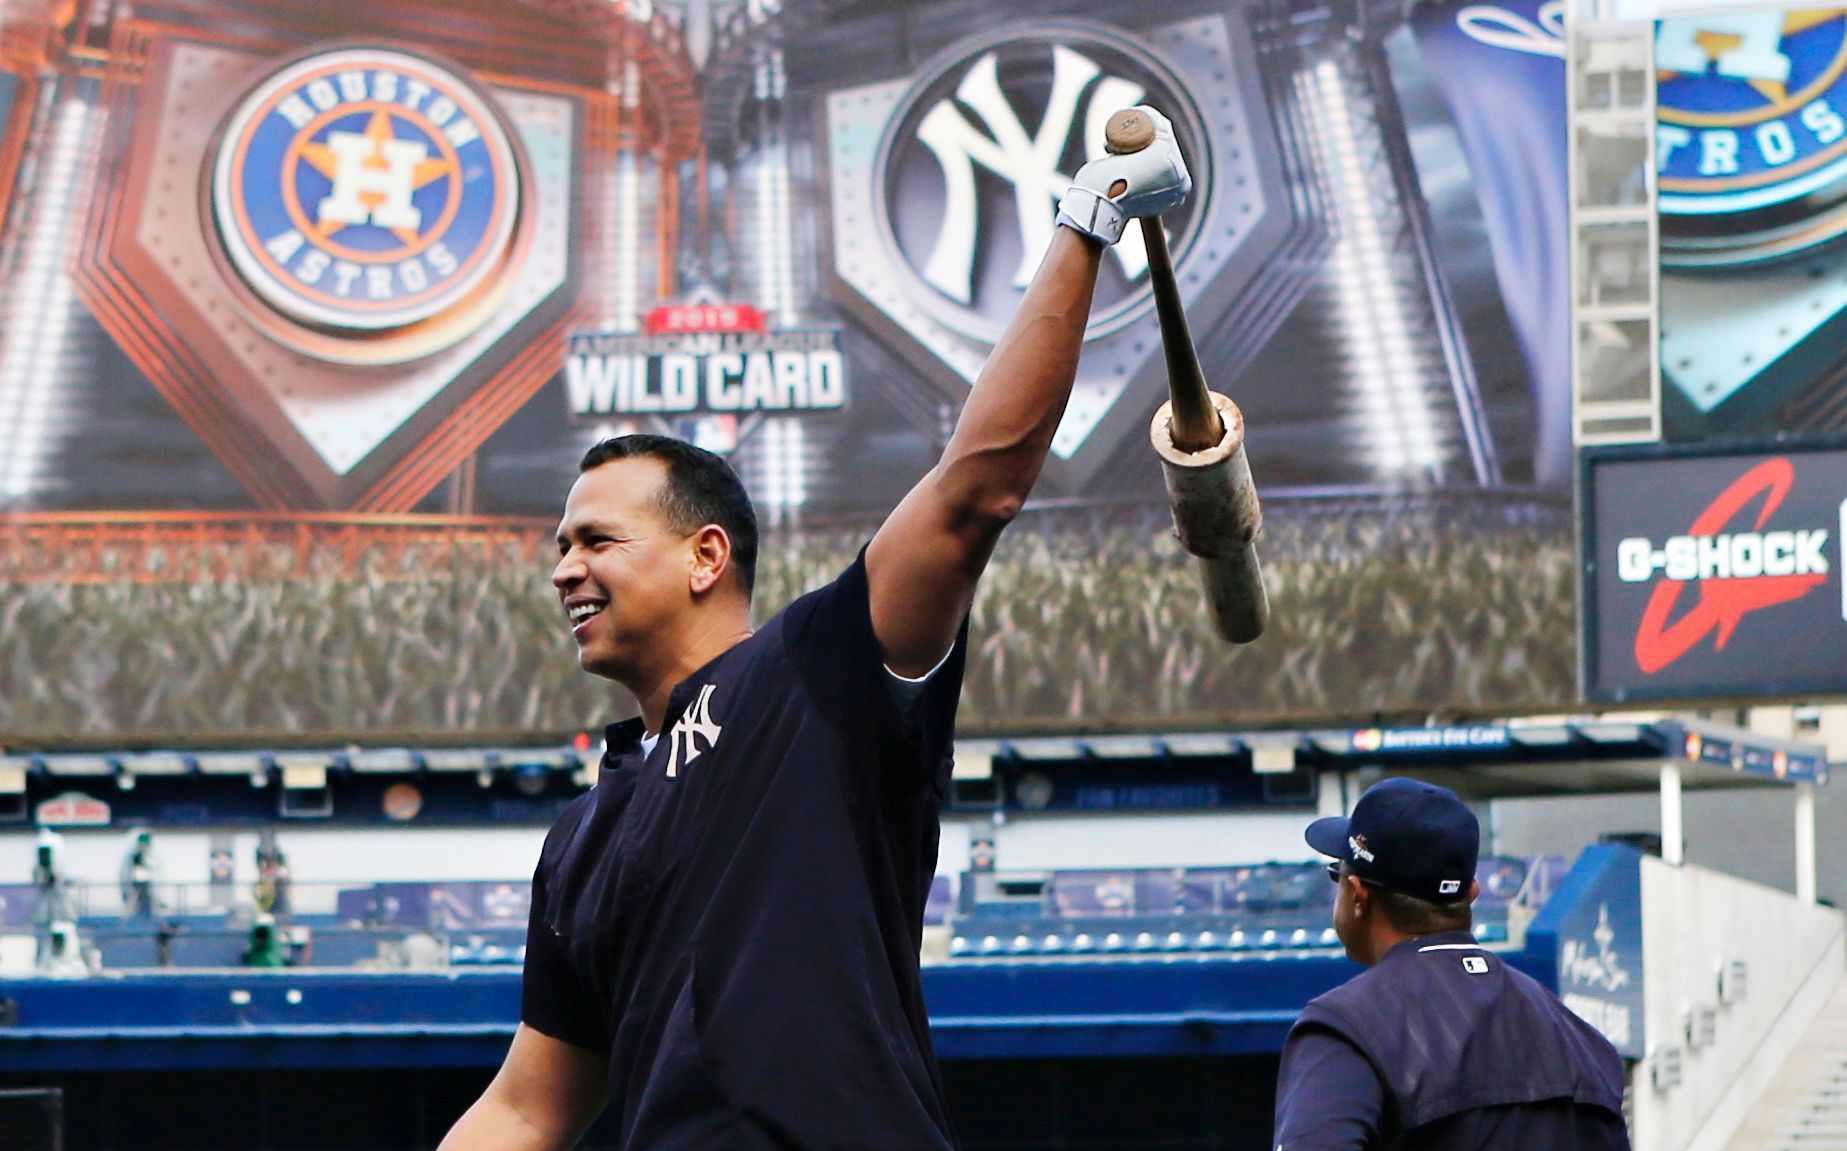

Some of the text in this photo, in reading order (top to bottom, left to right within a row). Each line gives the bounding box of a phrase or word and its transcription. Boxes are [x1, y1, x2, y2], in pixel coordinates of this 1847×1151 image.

[276, 69, 482, 150] HOUSTON
[318, 130, 428, 230] H
[264, 229, 459, 299] ASTROS
[567, 350, 844, 413] WILD CARD
[1618, 528, 1830, 582] G-SHOCK
